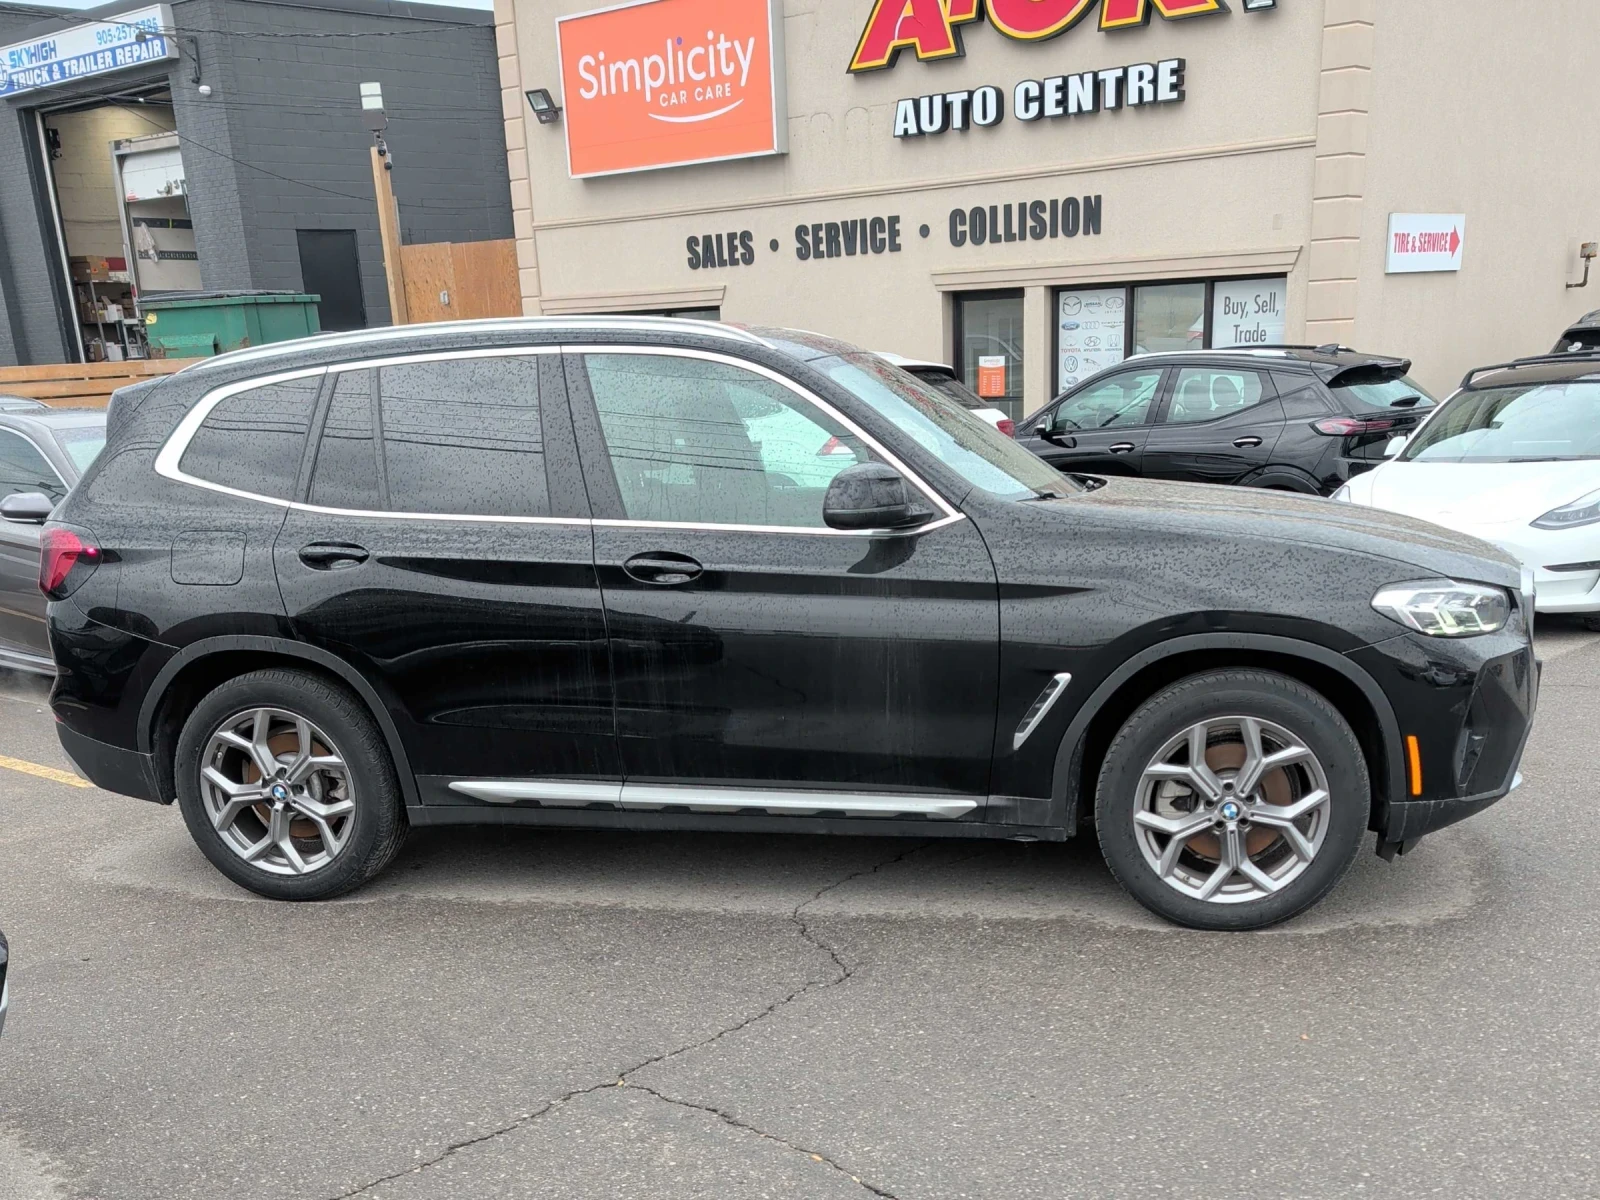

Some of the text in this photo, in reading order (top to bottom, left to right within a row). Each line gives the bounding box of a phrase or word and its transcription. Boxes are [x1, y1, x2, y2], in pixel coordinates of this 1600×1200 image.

[8, 40, 58, 69] SKYHIGH
[12, 39, 163, 89] TRUCK & TRAILER REPAIR
[578, 30, 755, 102] Simplicity
[659, 82, 732, 107] CAR CARE
[893, 57, 1186, 138] AUTO CENTRE
[686, 194, 1102, 270] SALES SERVICE COLLISION
[1393, 232, 1449, 253] TIRE & SERVICE
[1223, 291, 1279, 320] Buy, Sell,
[1233, 321, 1267, 343] Trade
